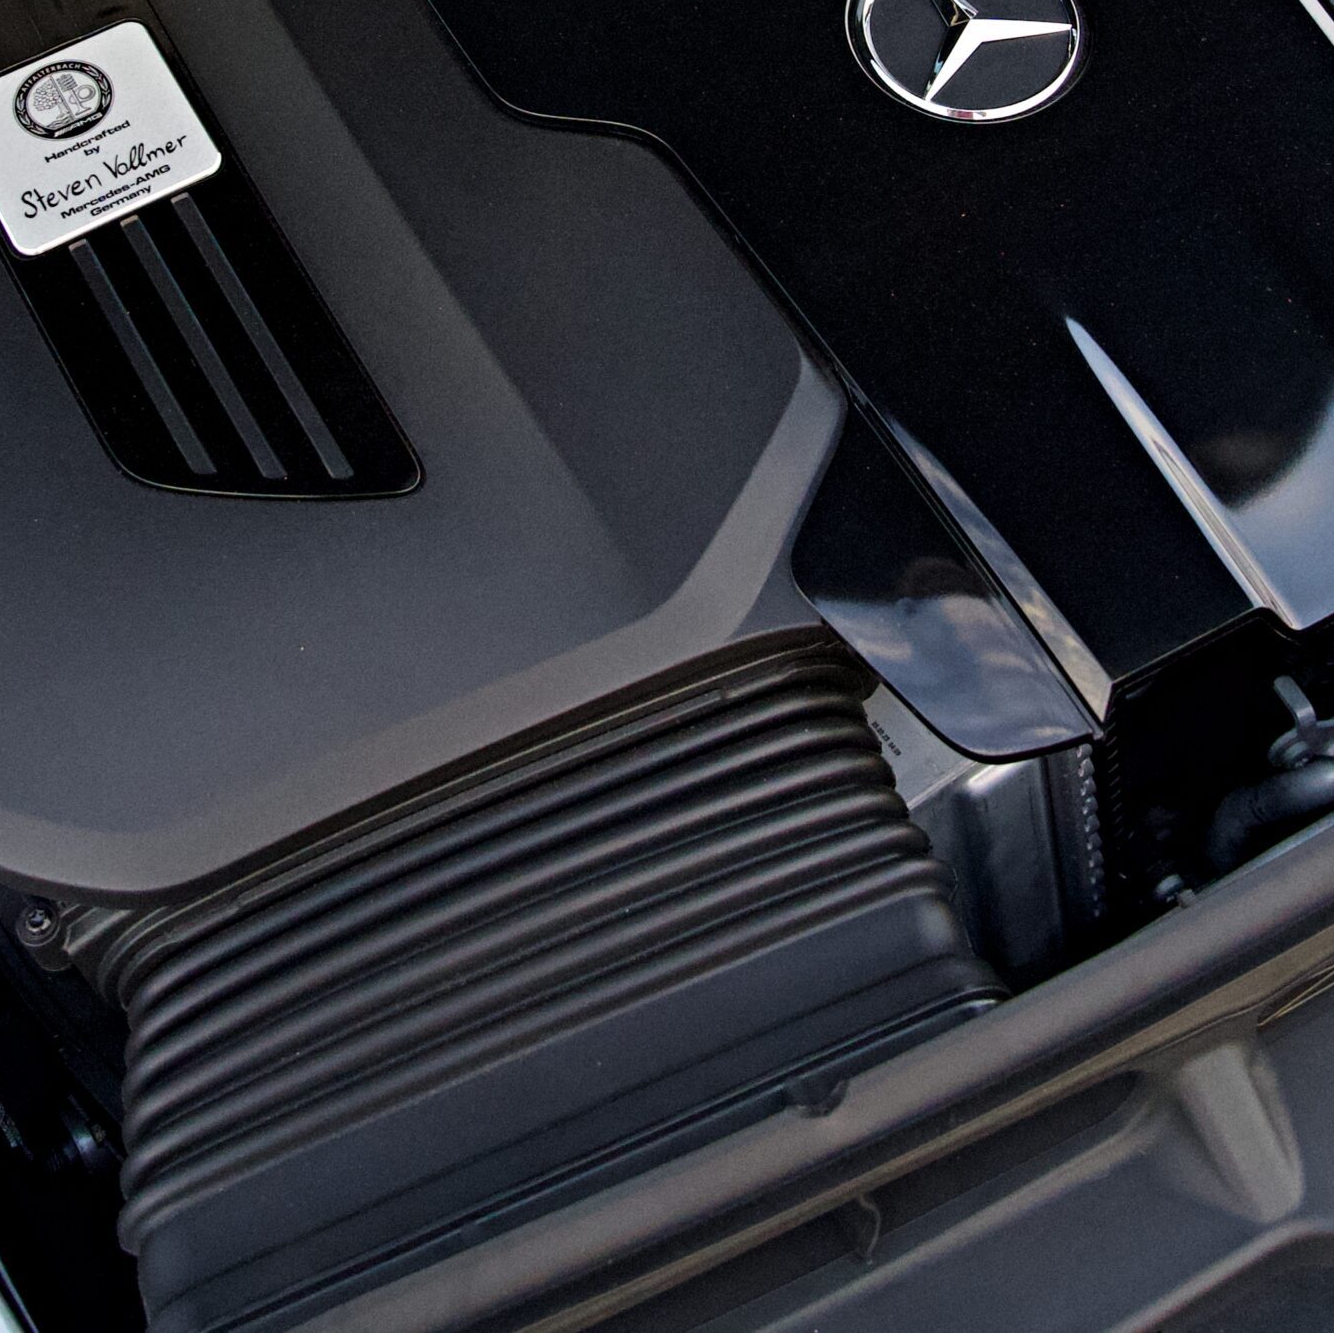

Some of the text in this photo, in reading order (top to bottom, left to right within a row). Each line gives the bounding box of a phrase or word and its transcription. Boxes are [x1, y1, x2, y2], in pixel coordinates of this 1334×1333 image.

[44, 120, 131, 163] Handcrafted
[84, 145, 100, 157] by
[21, 134, 187, 218] Steven Vollmer
[60, 164, 171, 219] Mercedes-AMG
[90, 184, 152, 217] Germany
